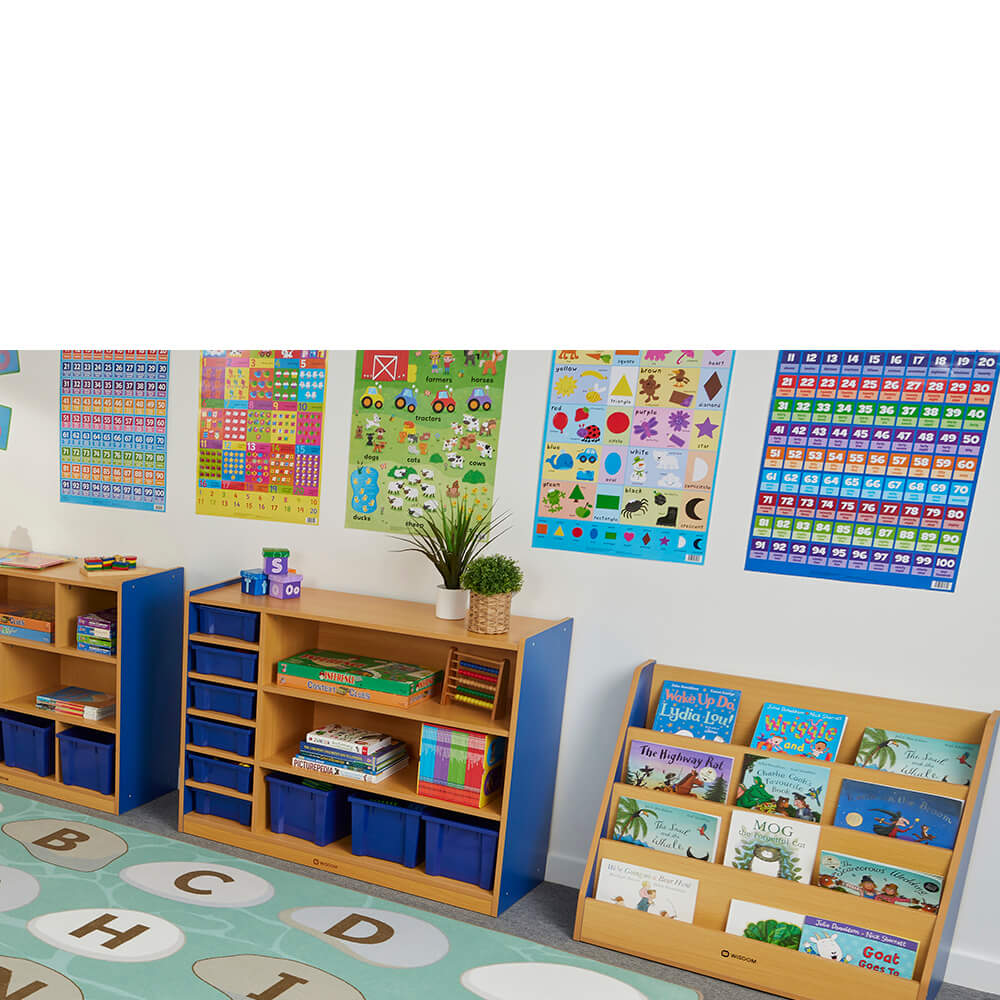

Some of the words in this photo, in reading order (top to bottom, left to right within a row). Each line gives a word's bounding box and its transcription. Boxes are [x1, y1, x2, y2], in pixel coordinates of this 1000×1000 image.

[787, 353, 795, 362] 11
[806, 353, 818, 362] 12
[826, 353, 838, 363] 13
[847, 354, 859, 363] 14
[869, 354, 881, 364] 15
[890, 355, 902, 365] 16
[912, 356, 924, 365] 17
[934, 356, 947, 367] 18
[957, 357, 970, 366] 19
[978, 357, 996, 367] 20
[782, 377, 793, 386] 21
[799, 377, 815, 387] 22
[820, 378, 836, 388] 23
[841, 379, 857, 388] 24
[862, 379, 878, 389] 25
[883, 380, 899, 390] 26
[906, 380, 922, 390] 27
[927, 381, 944, 392] 28
[950, 382, 967, 392] 29
[973, 383, 990, 393] 30
[777, 401, 789, 410] 31
[796, 402, 811, 411] 32
[817, 402, 831, 412] 33
[837, 403, 852, 413] 34
[858, 404, 873, 414] 35
[879, 405, 894, 415] 36
[901, 406, 916, 416] 37
[923, 407, 939, 417] 38
[945, 407, 962, 417] 39
[967, 409, 985, 419] 40
[272, 558, 283, 574] S
[665, 688, 696, 704] Wake
[697, 692, 715, 709] Up
[660, 701, 700, 722] Lydia
[704, 711, 734, 728] Lou!
[765, 714, 838, 744] Wriggle
[784, 742, 805, 752] and
[294, 759, 334, 775] PICTUREPEDIA
[640, 745, 658, 758] The
[659, 749, 703, 769] Highway
[704, 756, 724, 770] Rat
[756, 769, 786, 779] Charlie
[754, 819, 793, 837] MOG
[31, 827, 91, 852] B
[739, 827, 752, 837] the
[792, 840, 807, 849] cat
[174, 870, 235, 895] C
[890, 870, 928, 896] Wedding
[68, 913, 150, 950] H
[323, 913, 395, 945] D
[865, 932, 878, 940] Nick
[863, 946, 900, 965] Goat
[858, 959, 886, 973] Goes
[887, 967, 900, 977] To
